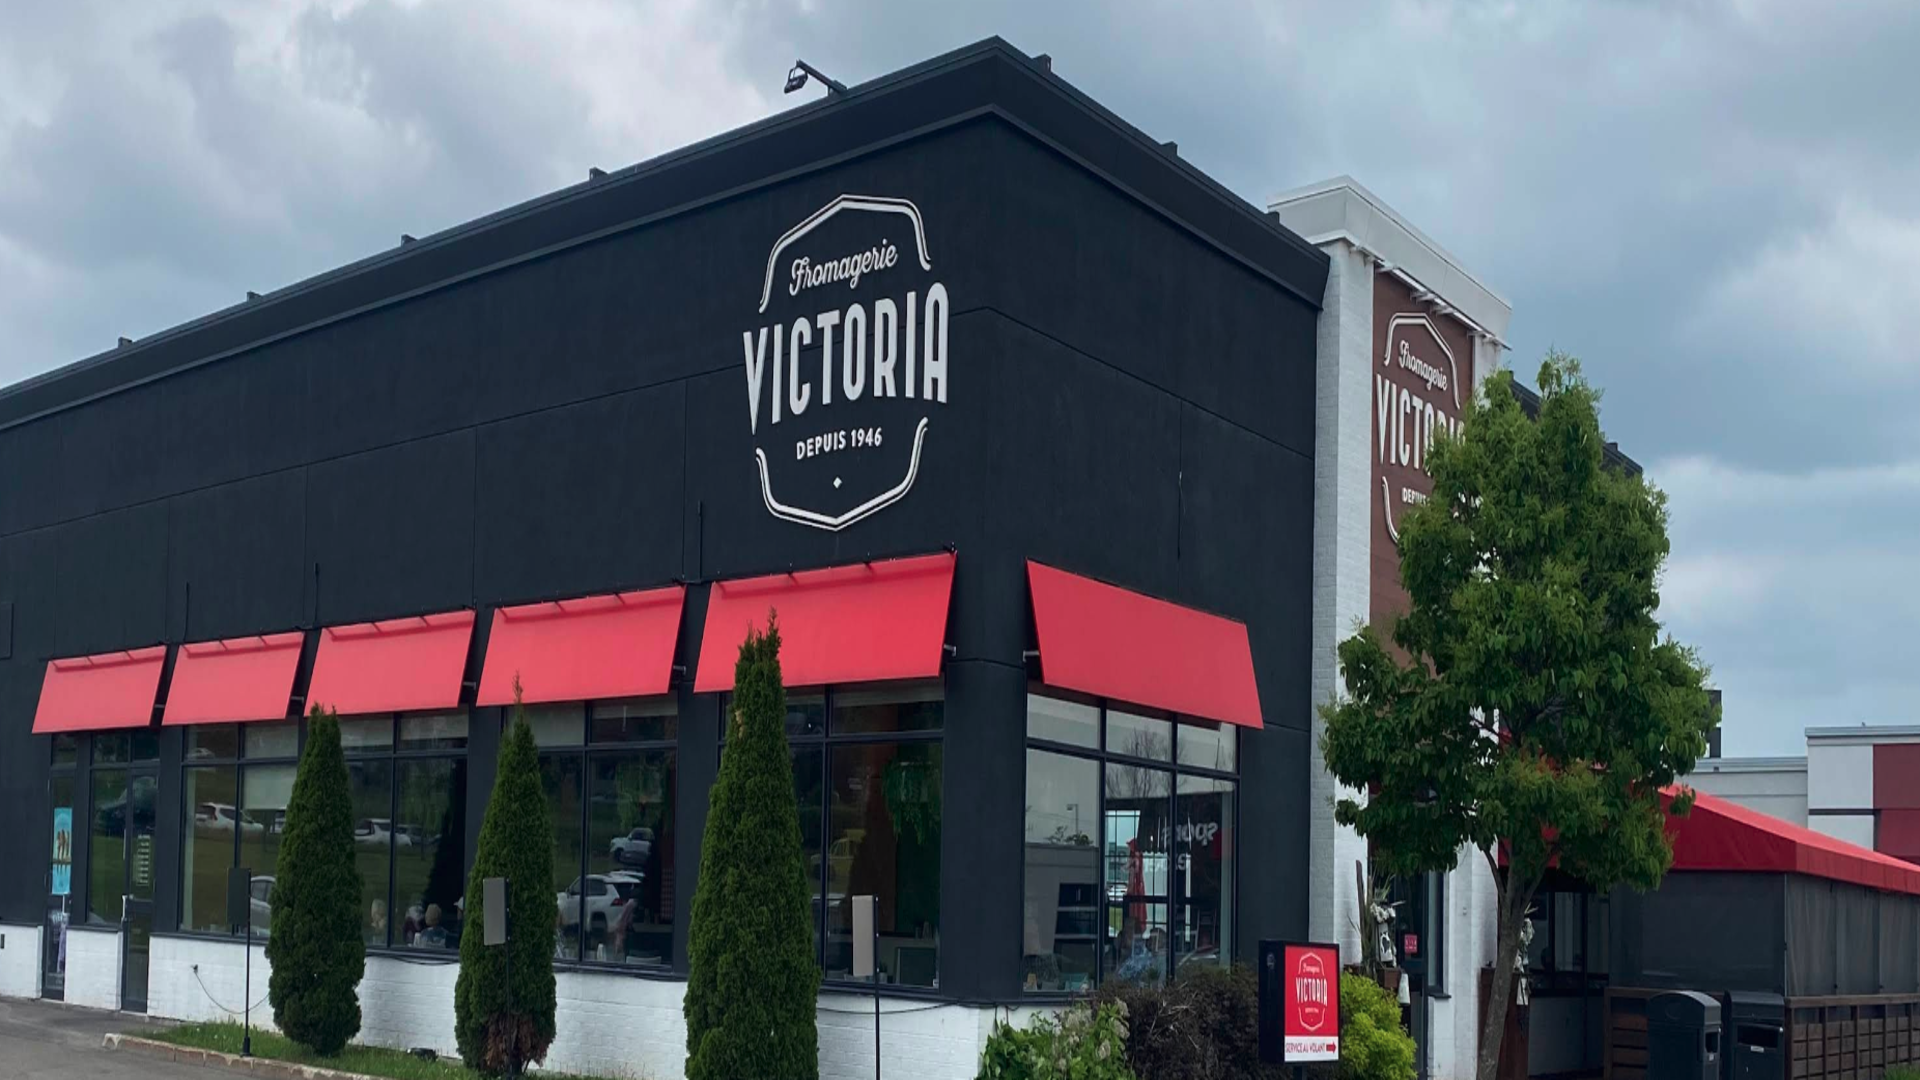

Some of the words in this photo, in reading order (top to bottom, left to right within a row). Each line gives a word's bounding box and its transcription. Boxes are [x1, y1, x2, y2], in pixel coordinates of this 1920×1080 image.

[789, 238, 898, 296] Fromagerie
[743, 282, 949, 436] VICTORIA
[1399, 340, 1447, 390] Fromagerie
[796, 430, 847, 460] DEPUIS
[850, 427, 883, 448] 1946
[1377, 374, 1465, 476] VICTO
[1296, 977, 1327, 1006] VICTORIA
[1286, 1043, 1303, 1053] SERVICE
[1309, 1042, 1326, 1053] VOLANT
